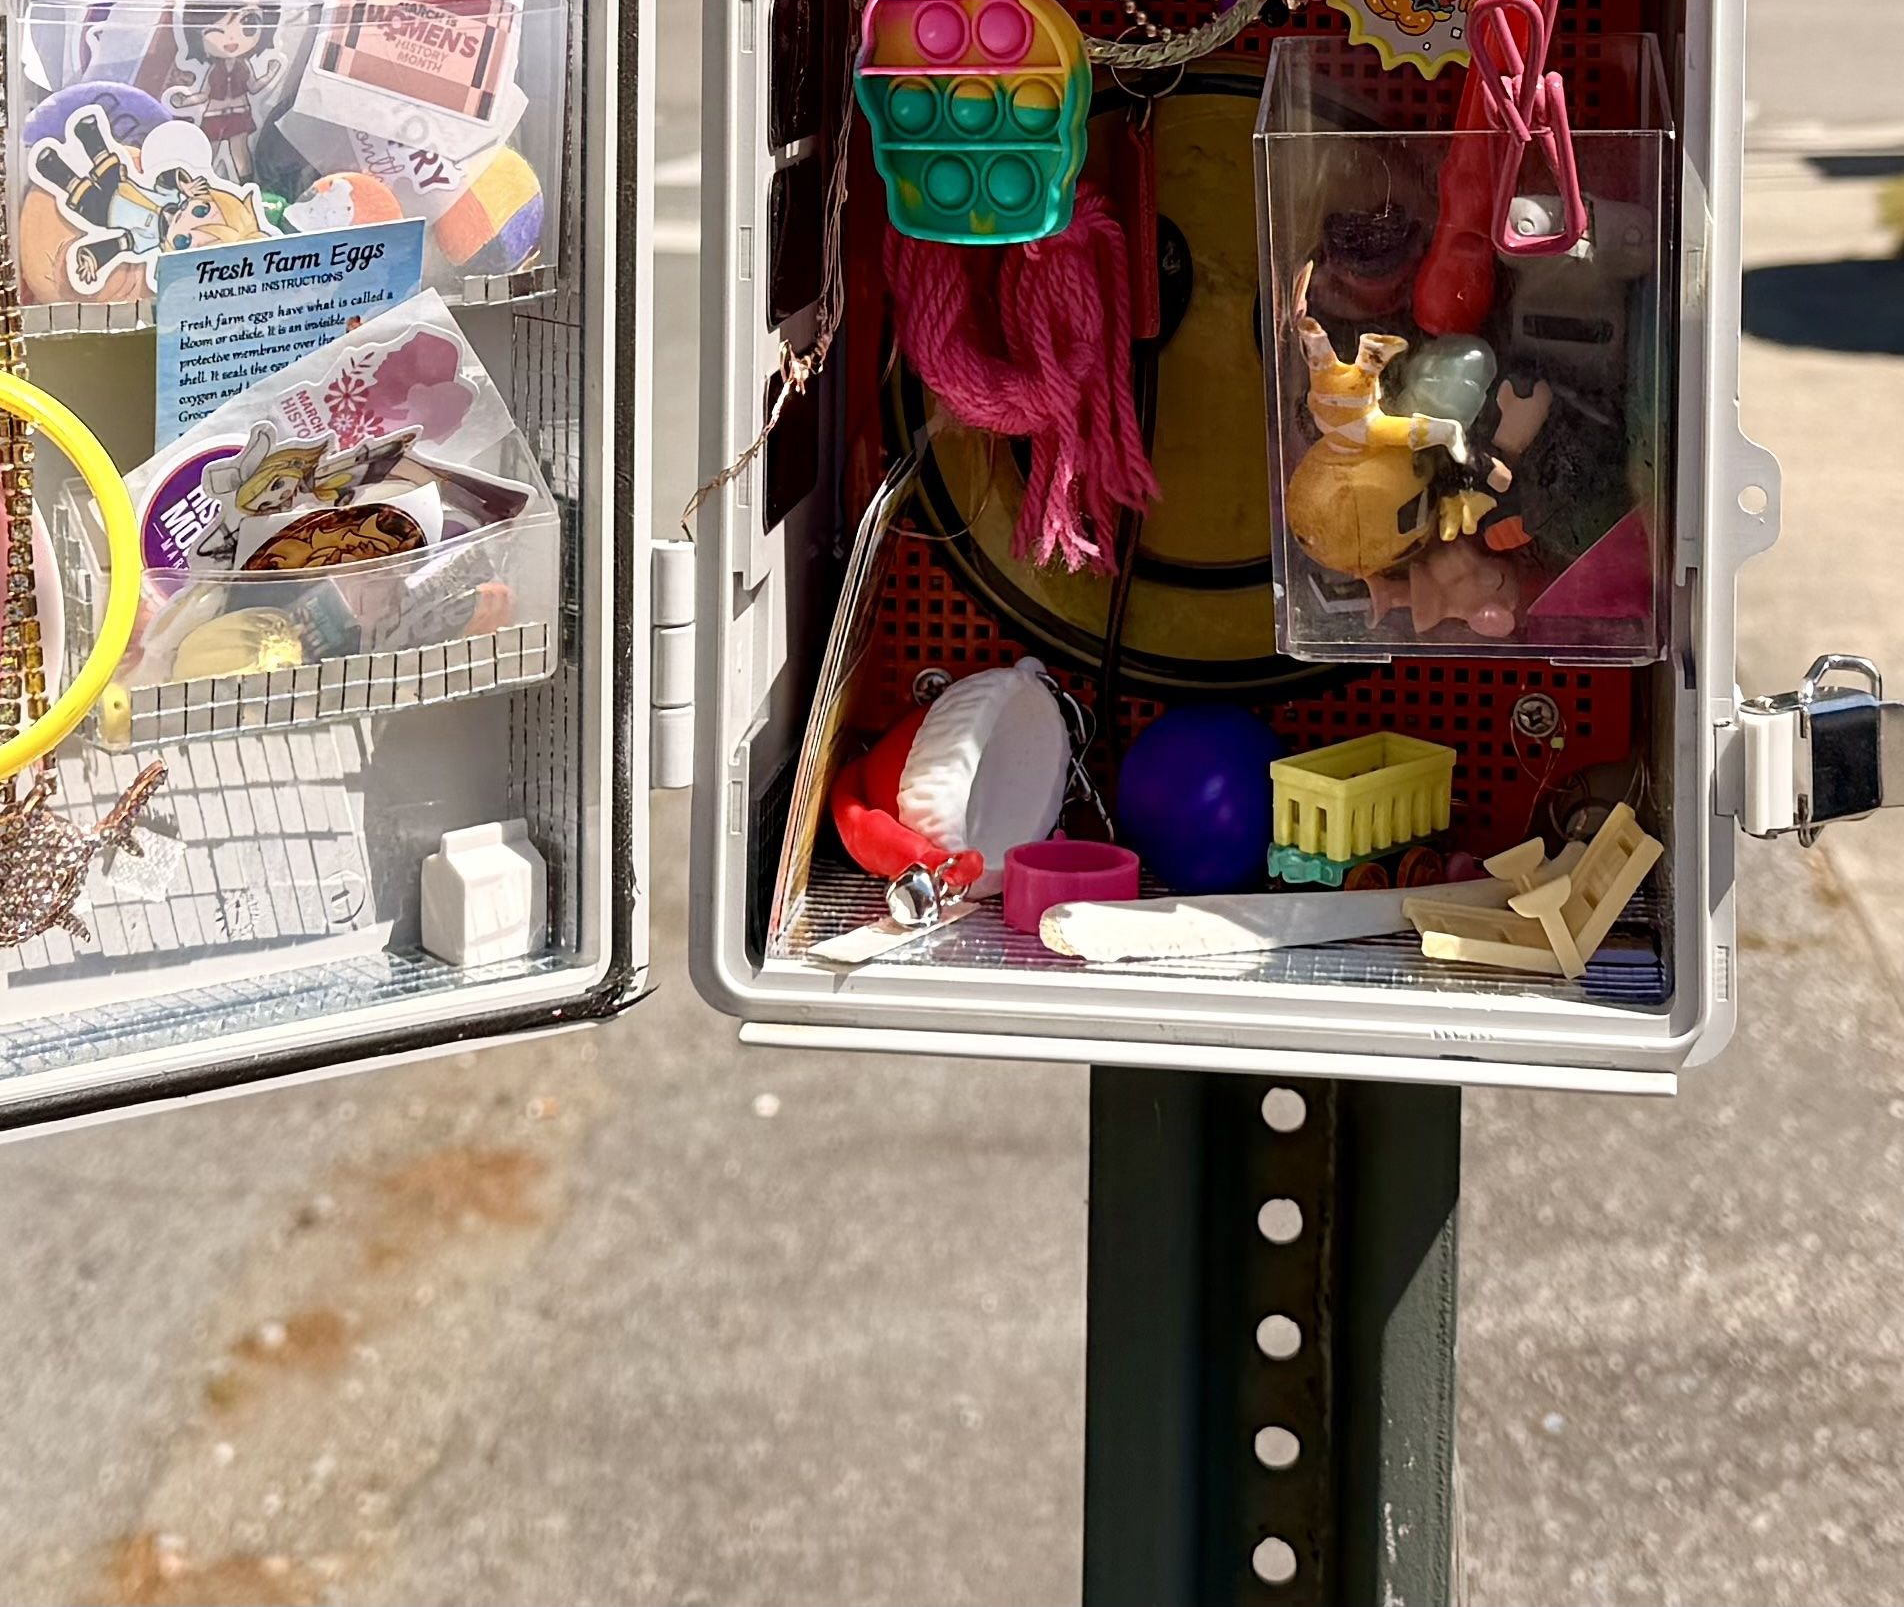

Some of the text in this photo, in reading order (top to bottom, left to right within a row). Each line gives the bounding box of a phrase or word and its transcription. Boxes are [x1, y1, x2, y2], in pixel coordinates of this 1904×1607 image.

[398, 2, 445, 23] MARCH
[367, 5, 479, 58] WOMEN'S
[395, 40, 447, 63] HISTORY
[397, 53, 442, 73] MONTH
[196, 243, 385, 284] Fresh Farm Eggs
[198, 271, 344, 301] HANDLING INSTRUCTIONS
[180, 289, 393, 331] Fresh farm eggs have what is called a
[180, 336, 213, 350] bloom
[215, 335, 227, 345] or
[267, 325, 276, 336] It
[278, 324, 286, 335] is
[288, 323, 302, 333] an
[304, 313, 345, 331] invisible
[179, 353, 230, 372] protective
[232, 343, 291, 360] membrane
[293, 339, 316, 350] over
[210, 370, 220, 382] It
[222, 364, 248, 380] seals
[250, 362, 268, 375] the
[179, 391, 218, 407] oxygen
[296, 390, 325, 433] MARCH
[281, 397, 314, 439] HISTO
[186, 484, 223, 527] HIS
[160, 498, 204, 557] MO
[160, 537, 189, 570] MAR
